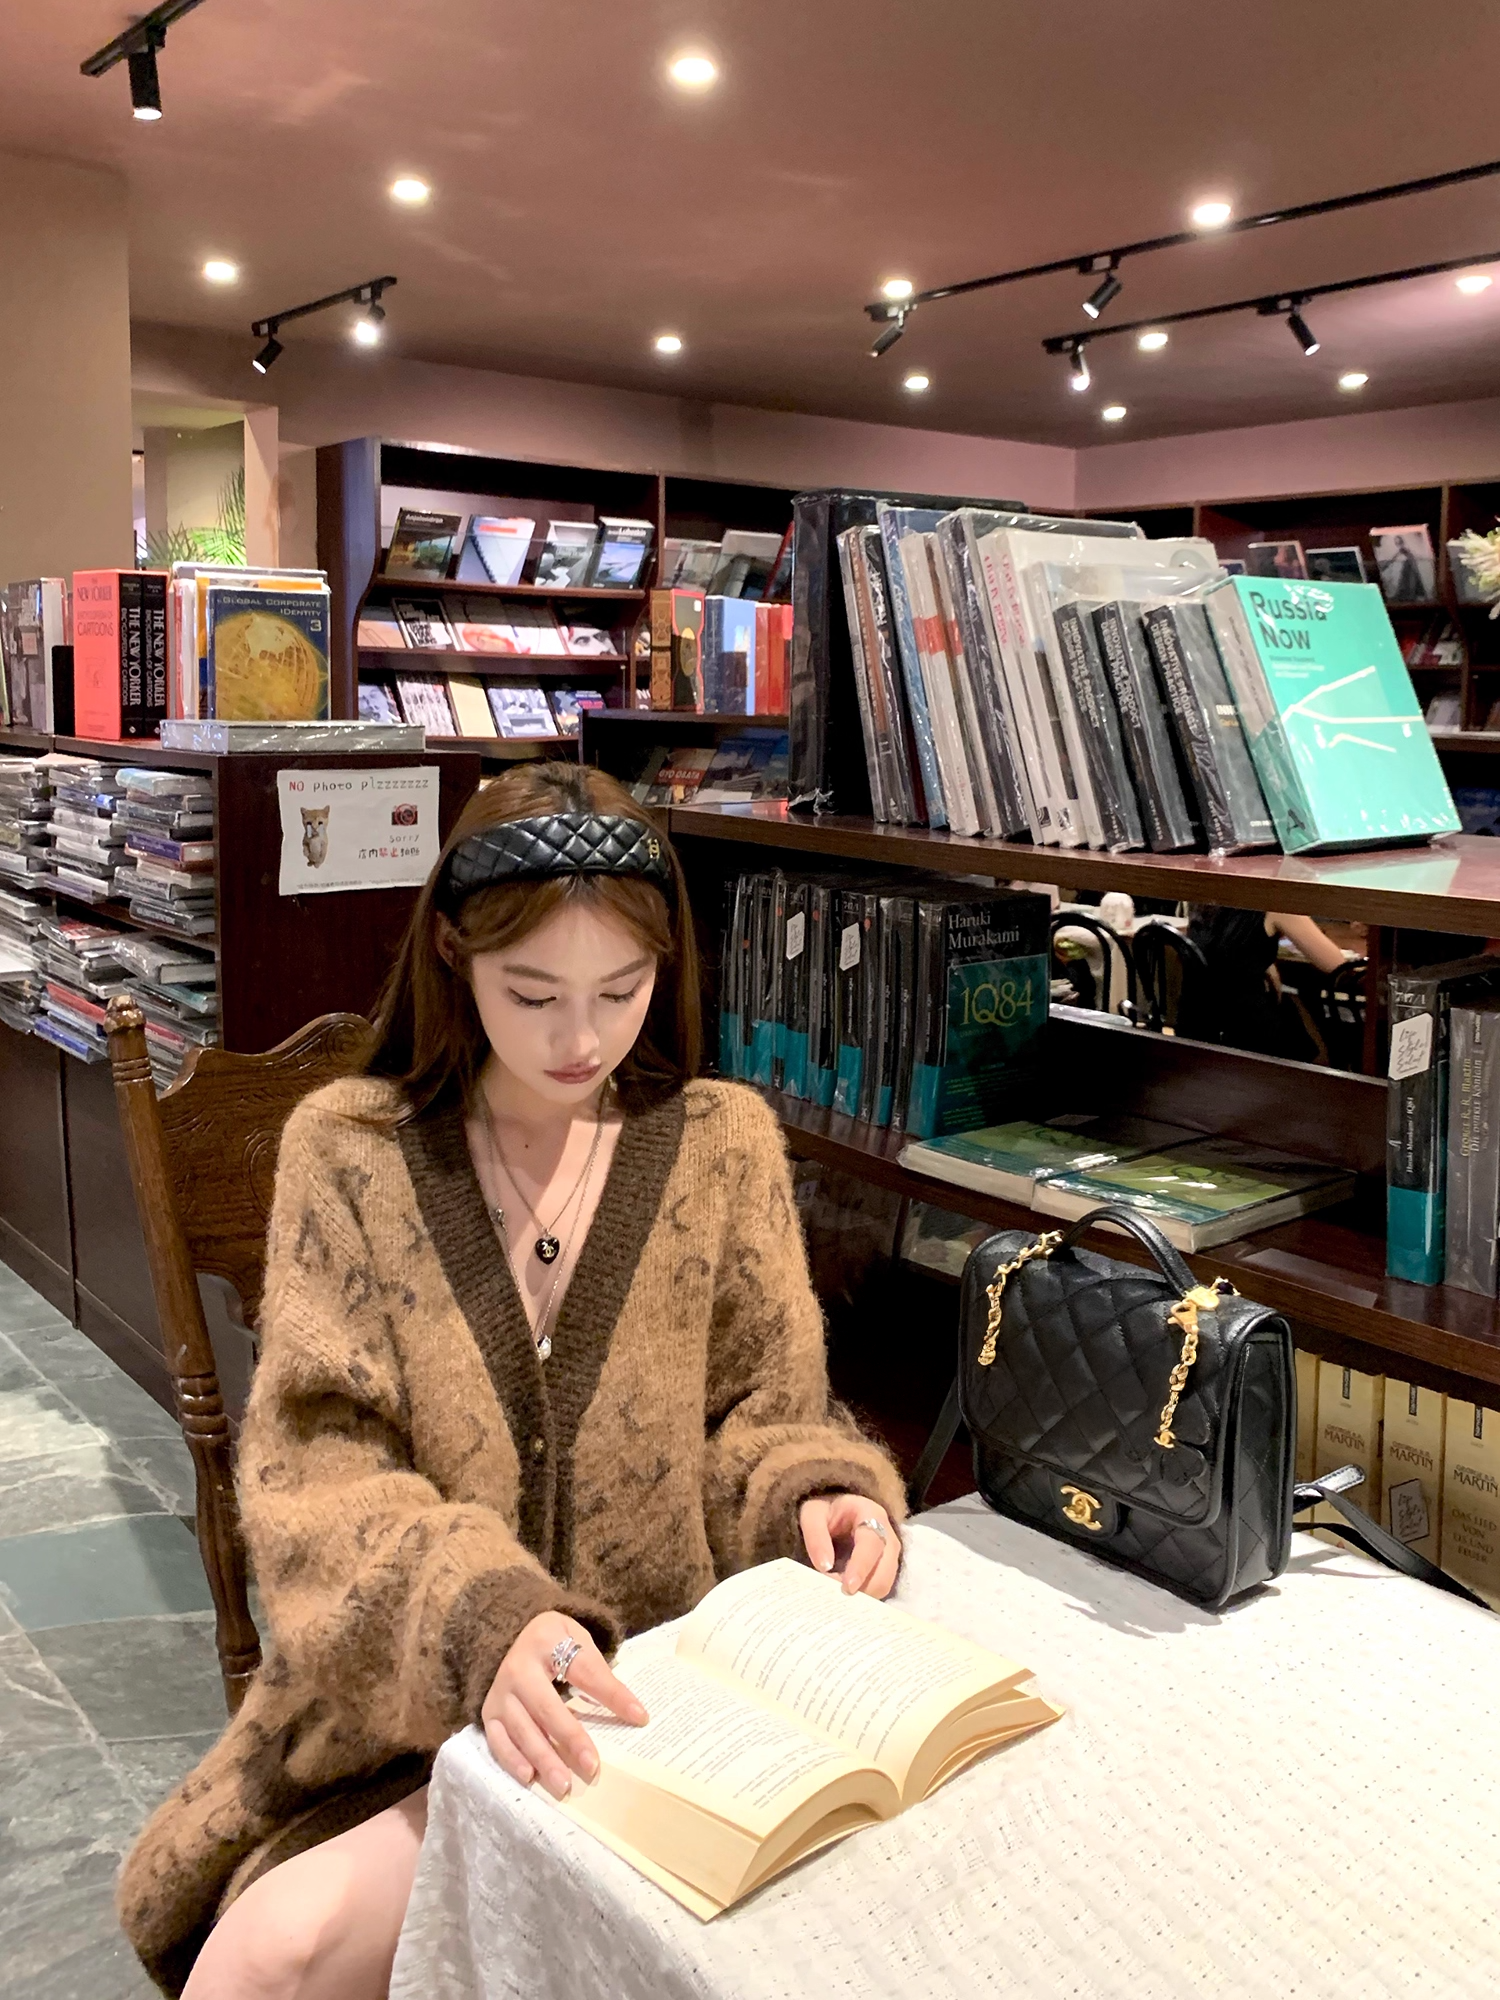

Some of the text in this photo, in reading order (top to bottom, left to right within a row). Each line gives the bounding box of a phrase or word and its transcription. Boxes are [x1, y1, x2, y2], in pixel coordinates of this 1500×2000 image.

[222, 596, 321, 608] GLOBAL CORPORATE
[280, 608, 322, 617] IDENTITY
[1248, 591, 1328, 622] Russia
[77, 622, 114, 637] CARTOONS
[310, 619, 322, 632] 3
[1258, 621, 1312, 650] Now
[129, 607, 142, 706] THE NEW YORKER
[153, 608, 165, 707] THE NEW YORKER
[1099, 622, 1129, 713] DESIGN PRACTICE
[1150, 623, 1182, 715] DESIGN PRACTICE
[1068, 617, 1100, 728] INNOVATIVE PRODUCT
[1107, 618, 1141, 729] INNOVATIVE PRODUCT
[1159, 619, 1197, 730] INNOVATIVE PRODUCT
[289, 780, 305, 792] NO
[313, 782, 353, 793] photo
[358, 847, 421, 859] 店内禁止拍照
[948, 911, 991, 930] Haruki
[948, 925, 1020, 950] Murakami
[960, 976, 1034, 1027] 1Q84
[1324, 1428, 1365, 1453] MARTIN
[1390, 1446, 1434, 1471] MARTIN
[1453, 1469, 1499, 1498] MARTIN
[1452, 1508, 1497, 1532] DAS LIED
[1462, 1523, 1486, 1539] VON
[1458, 1545, 1488, 1563] FEUER
[1470, 1539, 1494, 1554] UND
